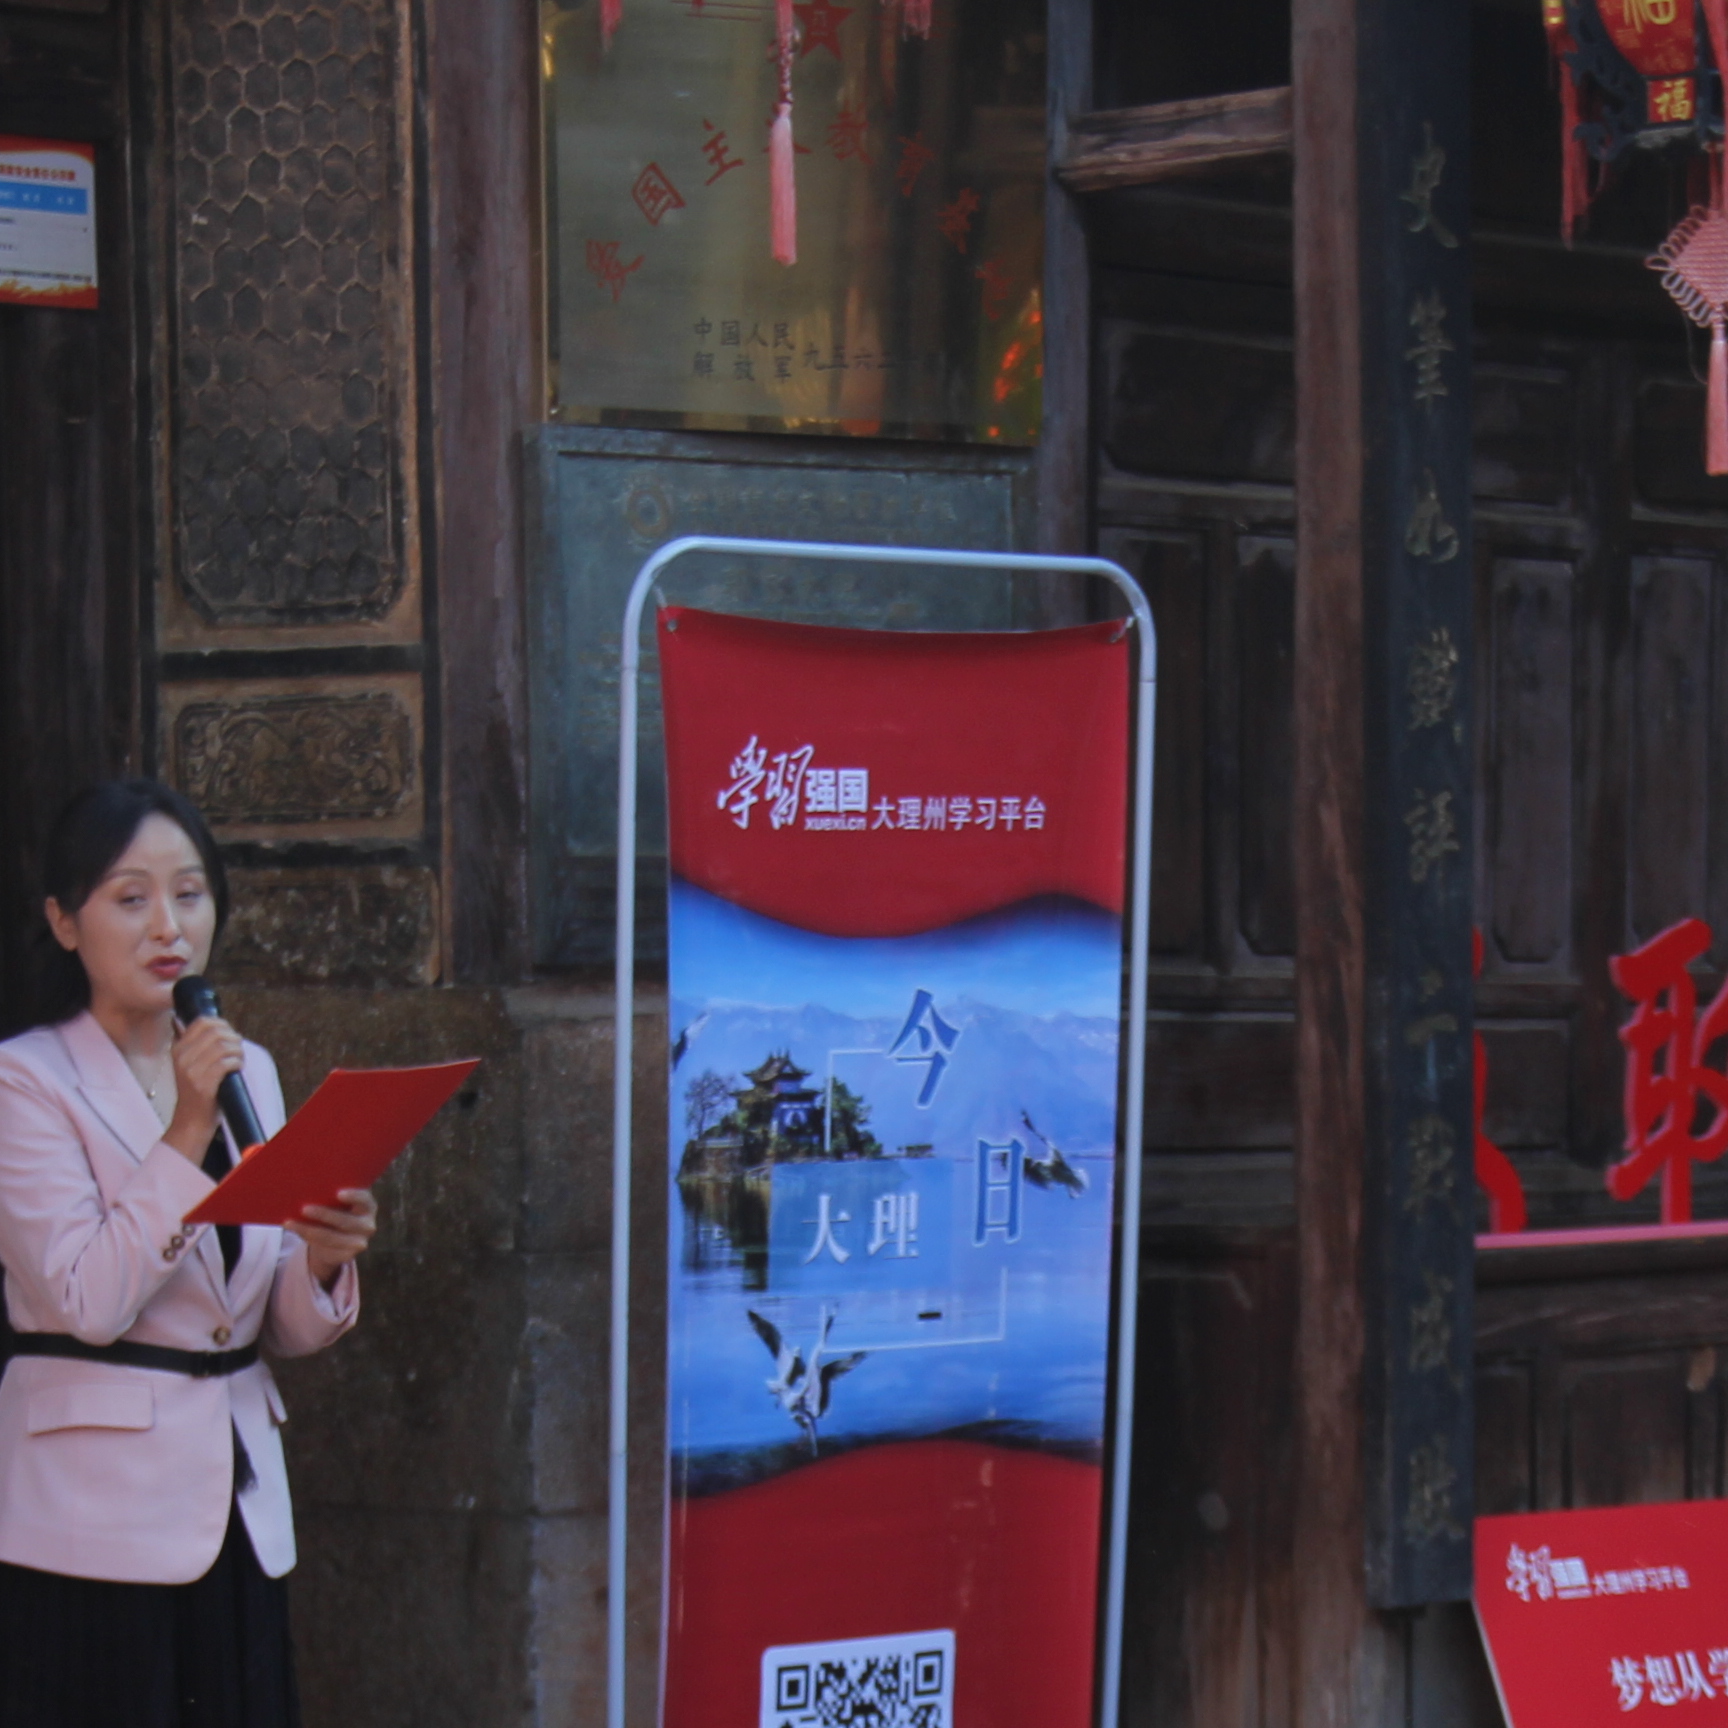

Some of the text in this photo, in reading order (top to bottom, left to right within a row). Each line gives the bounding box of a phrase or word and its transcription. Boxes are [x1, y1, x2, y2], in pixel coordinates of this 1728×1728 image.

[1654, 79, 1693, 122] 福
[872, 796, 1046, 832] 大理州学习平台
[802, 1191, 919, 1266] 大理
